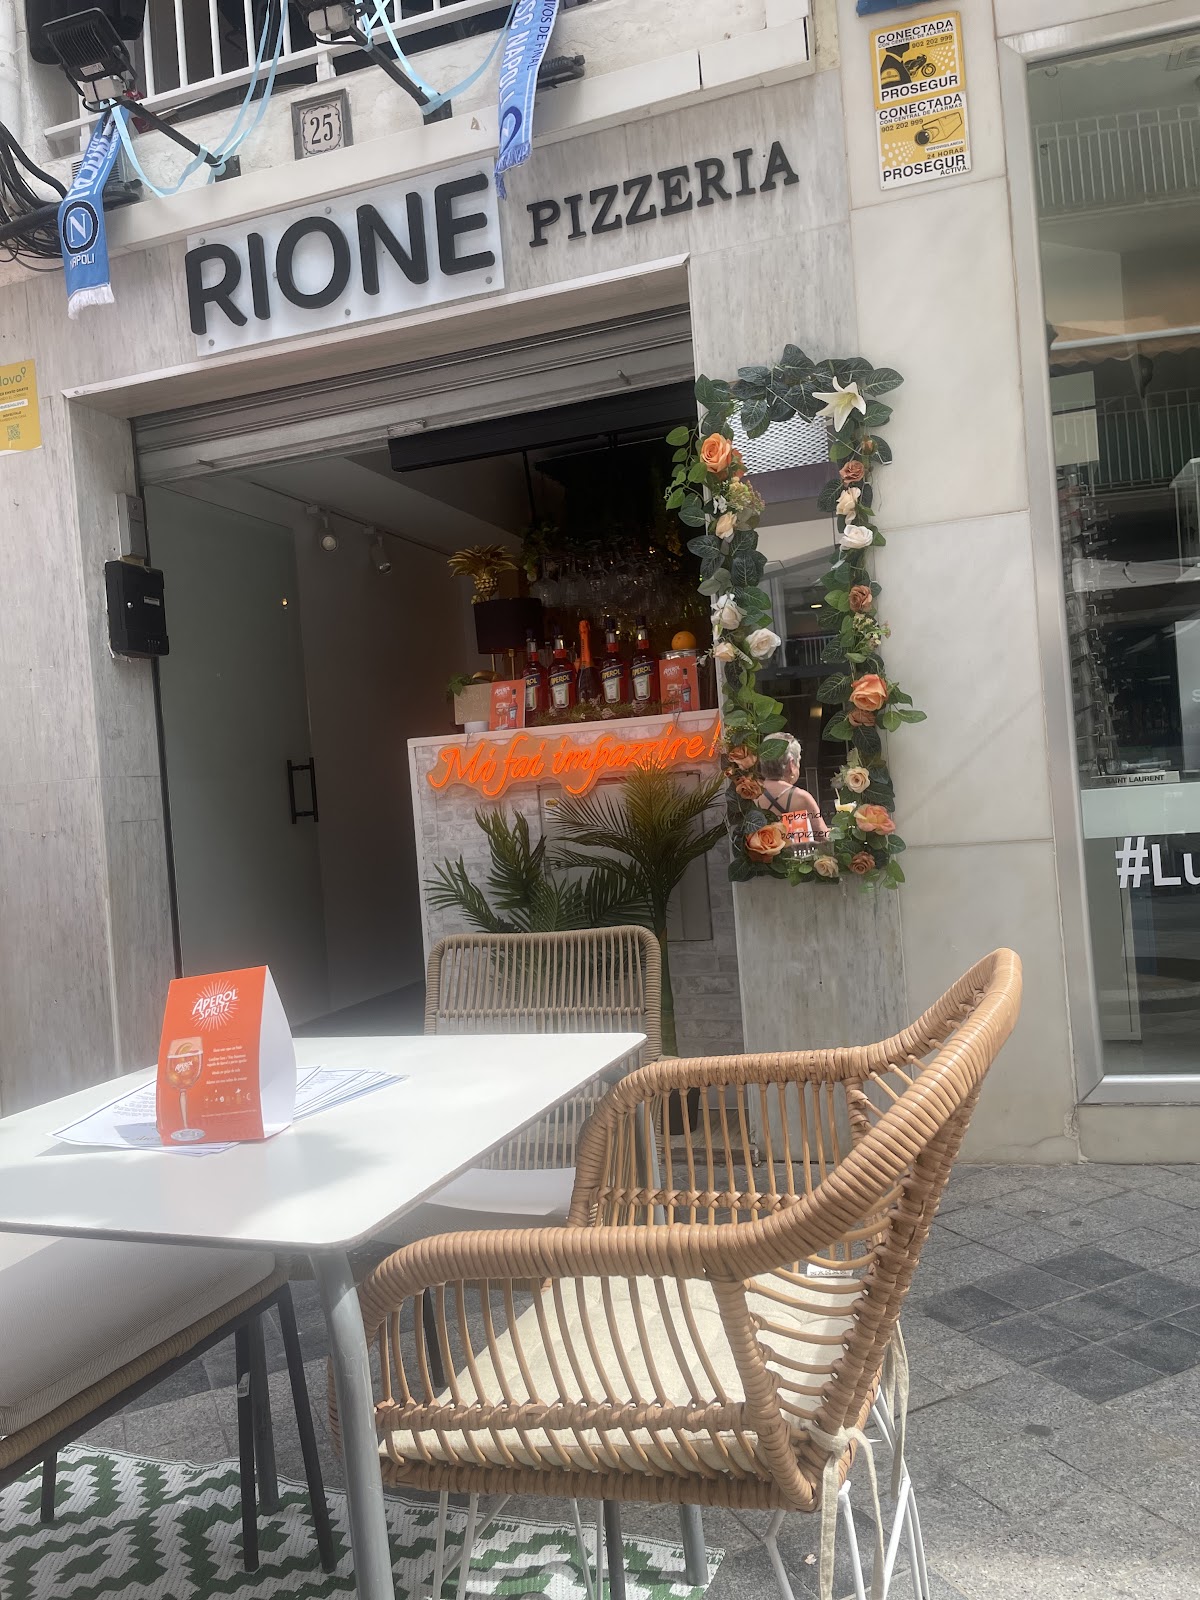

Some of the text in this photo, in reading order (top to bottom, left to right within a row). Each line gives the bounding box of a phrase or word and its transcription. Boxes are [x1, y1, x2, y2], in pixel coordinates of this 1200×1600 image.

[537, 26, 550, 41] DE
[877, 19, 953, 44] CONECTADA
[891, 36, 916, 46] CENTRAL
[925, 27, 954, 37] ALARMAS
[926, 38, 938, 46] 202
[940, 34, 953, 42] 999
[499, 0, 537, 109] SC NAPOLI
[526, 42, 546, 71] FINAL
[881, 75, 958, 101] PROSEGUR
[879, 93, 962, 120] CONECTADA
[894, 113, 920, 123] CENTRAL
[932, 103, 963, 114] ALARMAS
[310, 113, 333, 145] 25
[881, 118, 924, 133] 902 202 999
[937, 147, 964, 157] HORAS
[883, 154, 966, 182] PROSEGUR
[69, 213, 87, 243] N
[184, 140, 800, 336] RIONE PIZZERIA
[482, 735, 546, 796] fai
[1128, 774, 1165, 783] LAURENT
[192, 989, 238, 1015] APEROL
